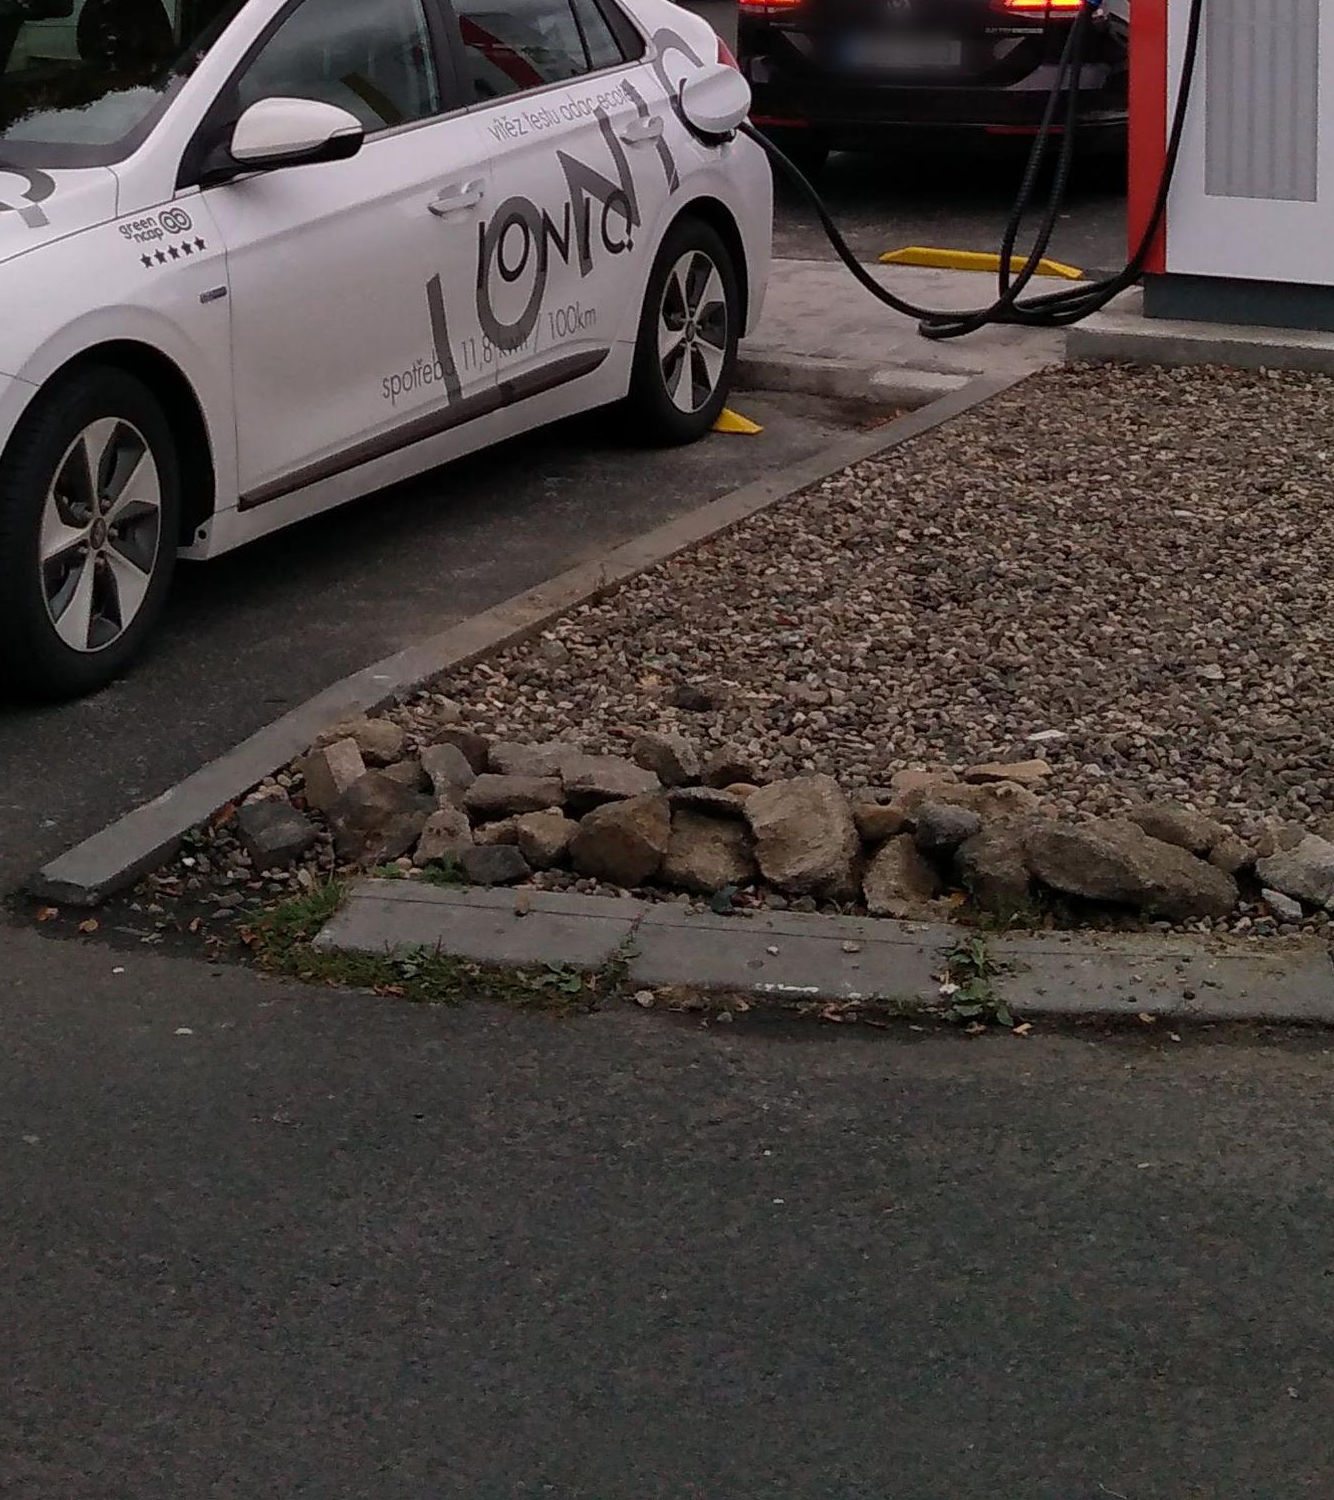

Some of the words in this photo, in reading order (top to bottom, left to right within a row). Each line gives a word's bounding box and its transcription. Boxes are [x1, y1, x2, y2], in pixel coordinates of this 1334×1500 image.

[118, 216, 158, 240] green
[133, 226, 165, 243] ncap
[478, 189, 635, 290] IONIQ
[548, 300, 597, 340] 100km
